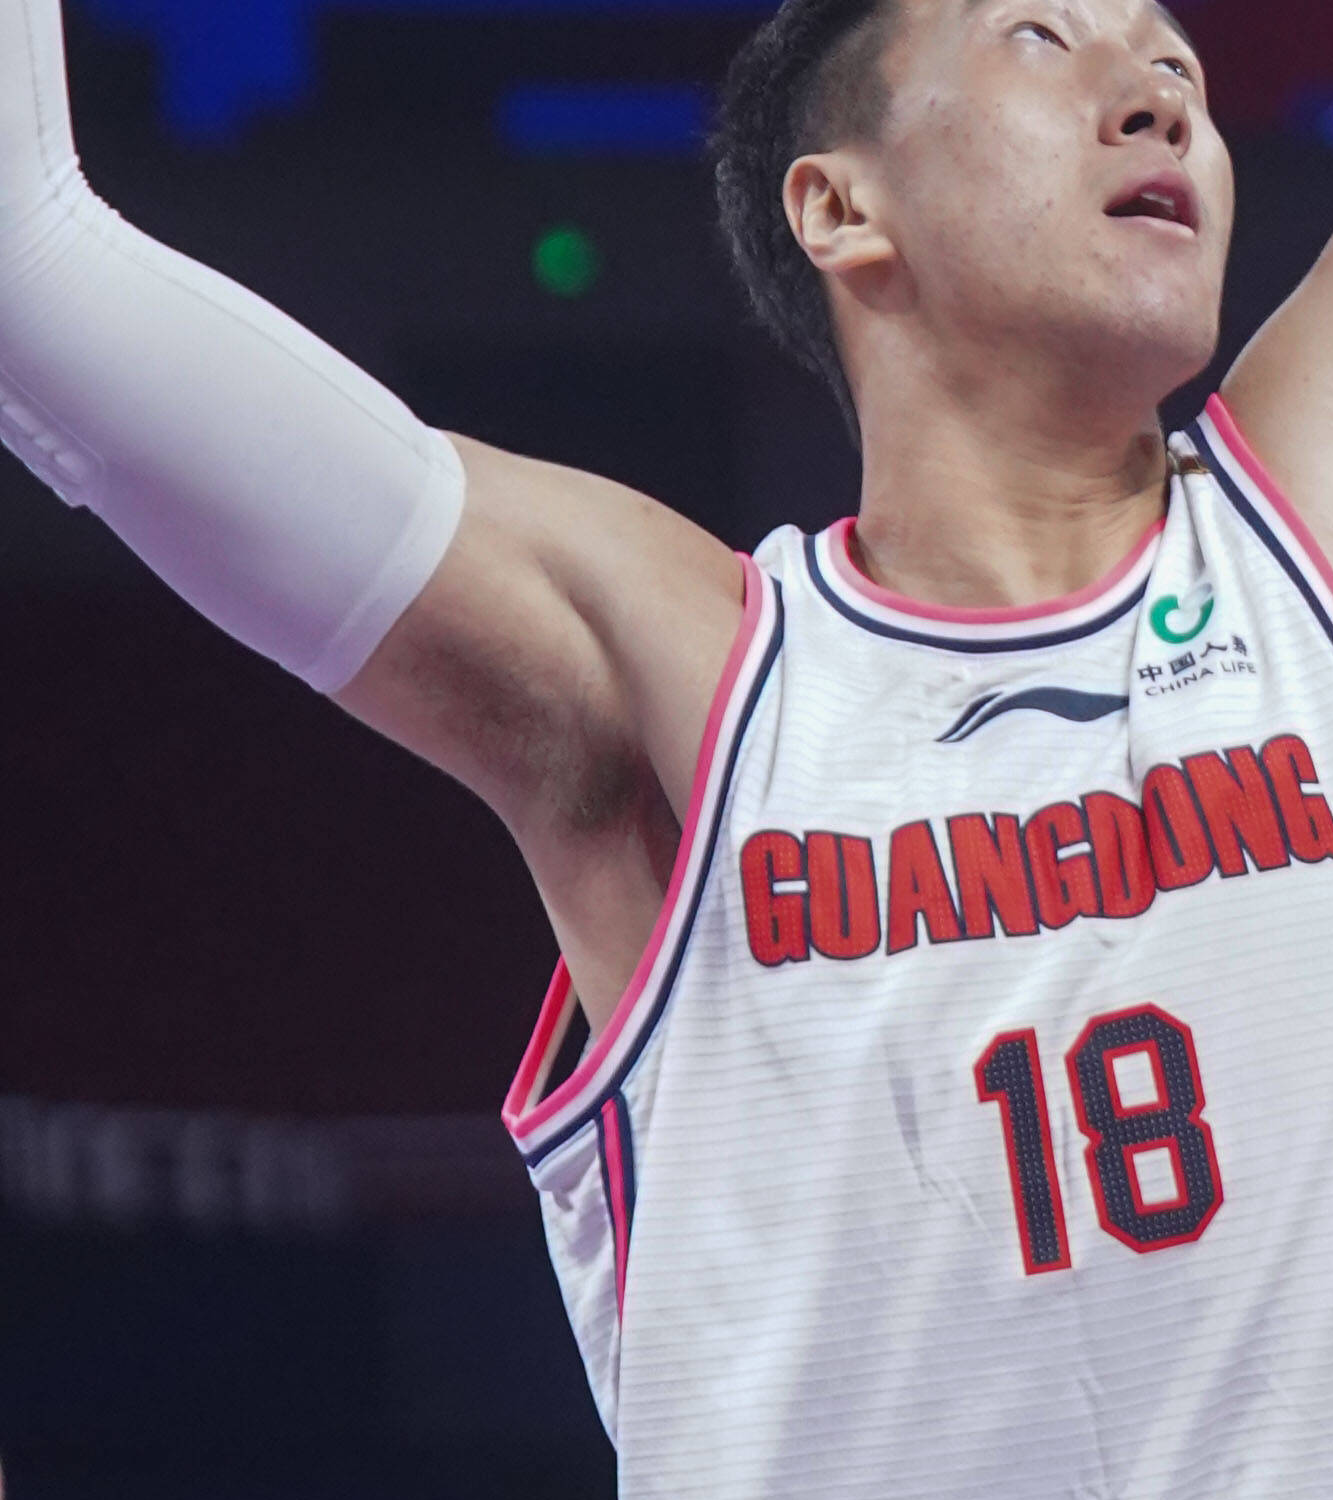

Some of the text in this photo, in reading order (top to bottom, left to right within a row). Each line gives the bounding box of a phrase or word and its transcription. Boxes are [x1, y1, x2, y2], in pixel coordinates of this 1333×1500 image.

[1144, 660, 1256, 696] CHINA LIFE
[973, 1002, 1224, 1276] 18
